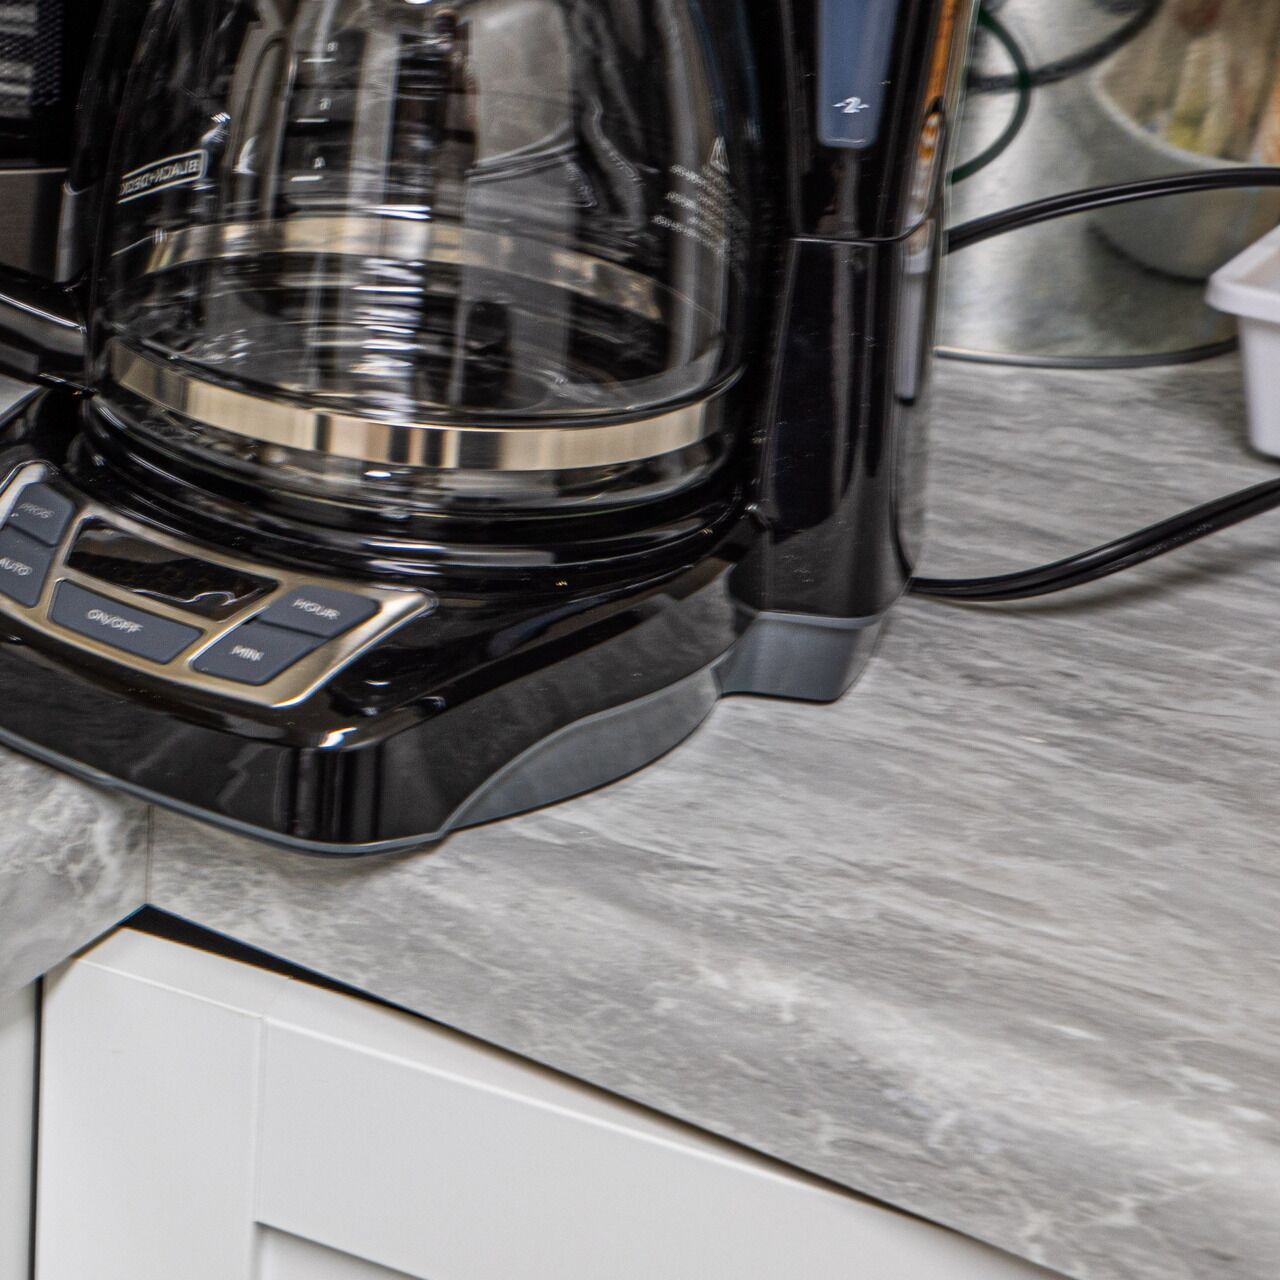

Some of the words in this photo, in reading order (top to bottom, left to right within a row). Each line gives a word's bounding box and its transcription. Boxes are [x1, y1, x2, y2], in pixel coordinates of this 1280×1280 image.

[87, 608, 145, 634] ON/OFF
[292, 598, 342, 621] HOUR
[229, 643, 266, 662] MIN
